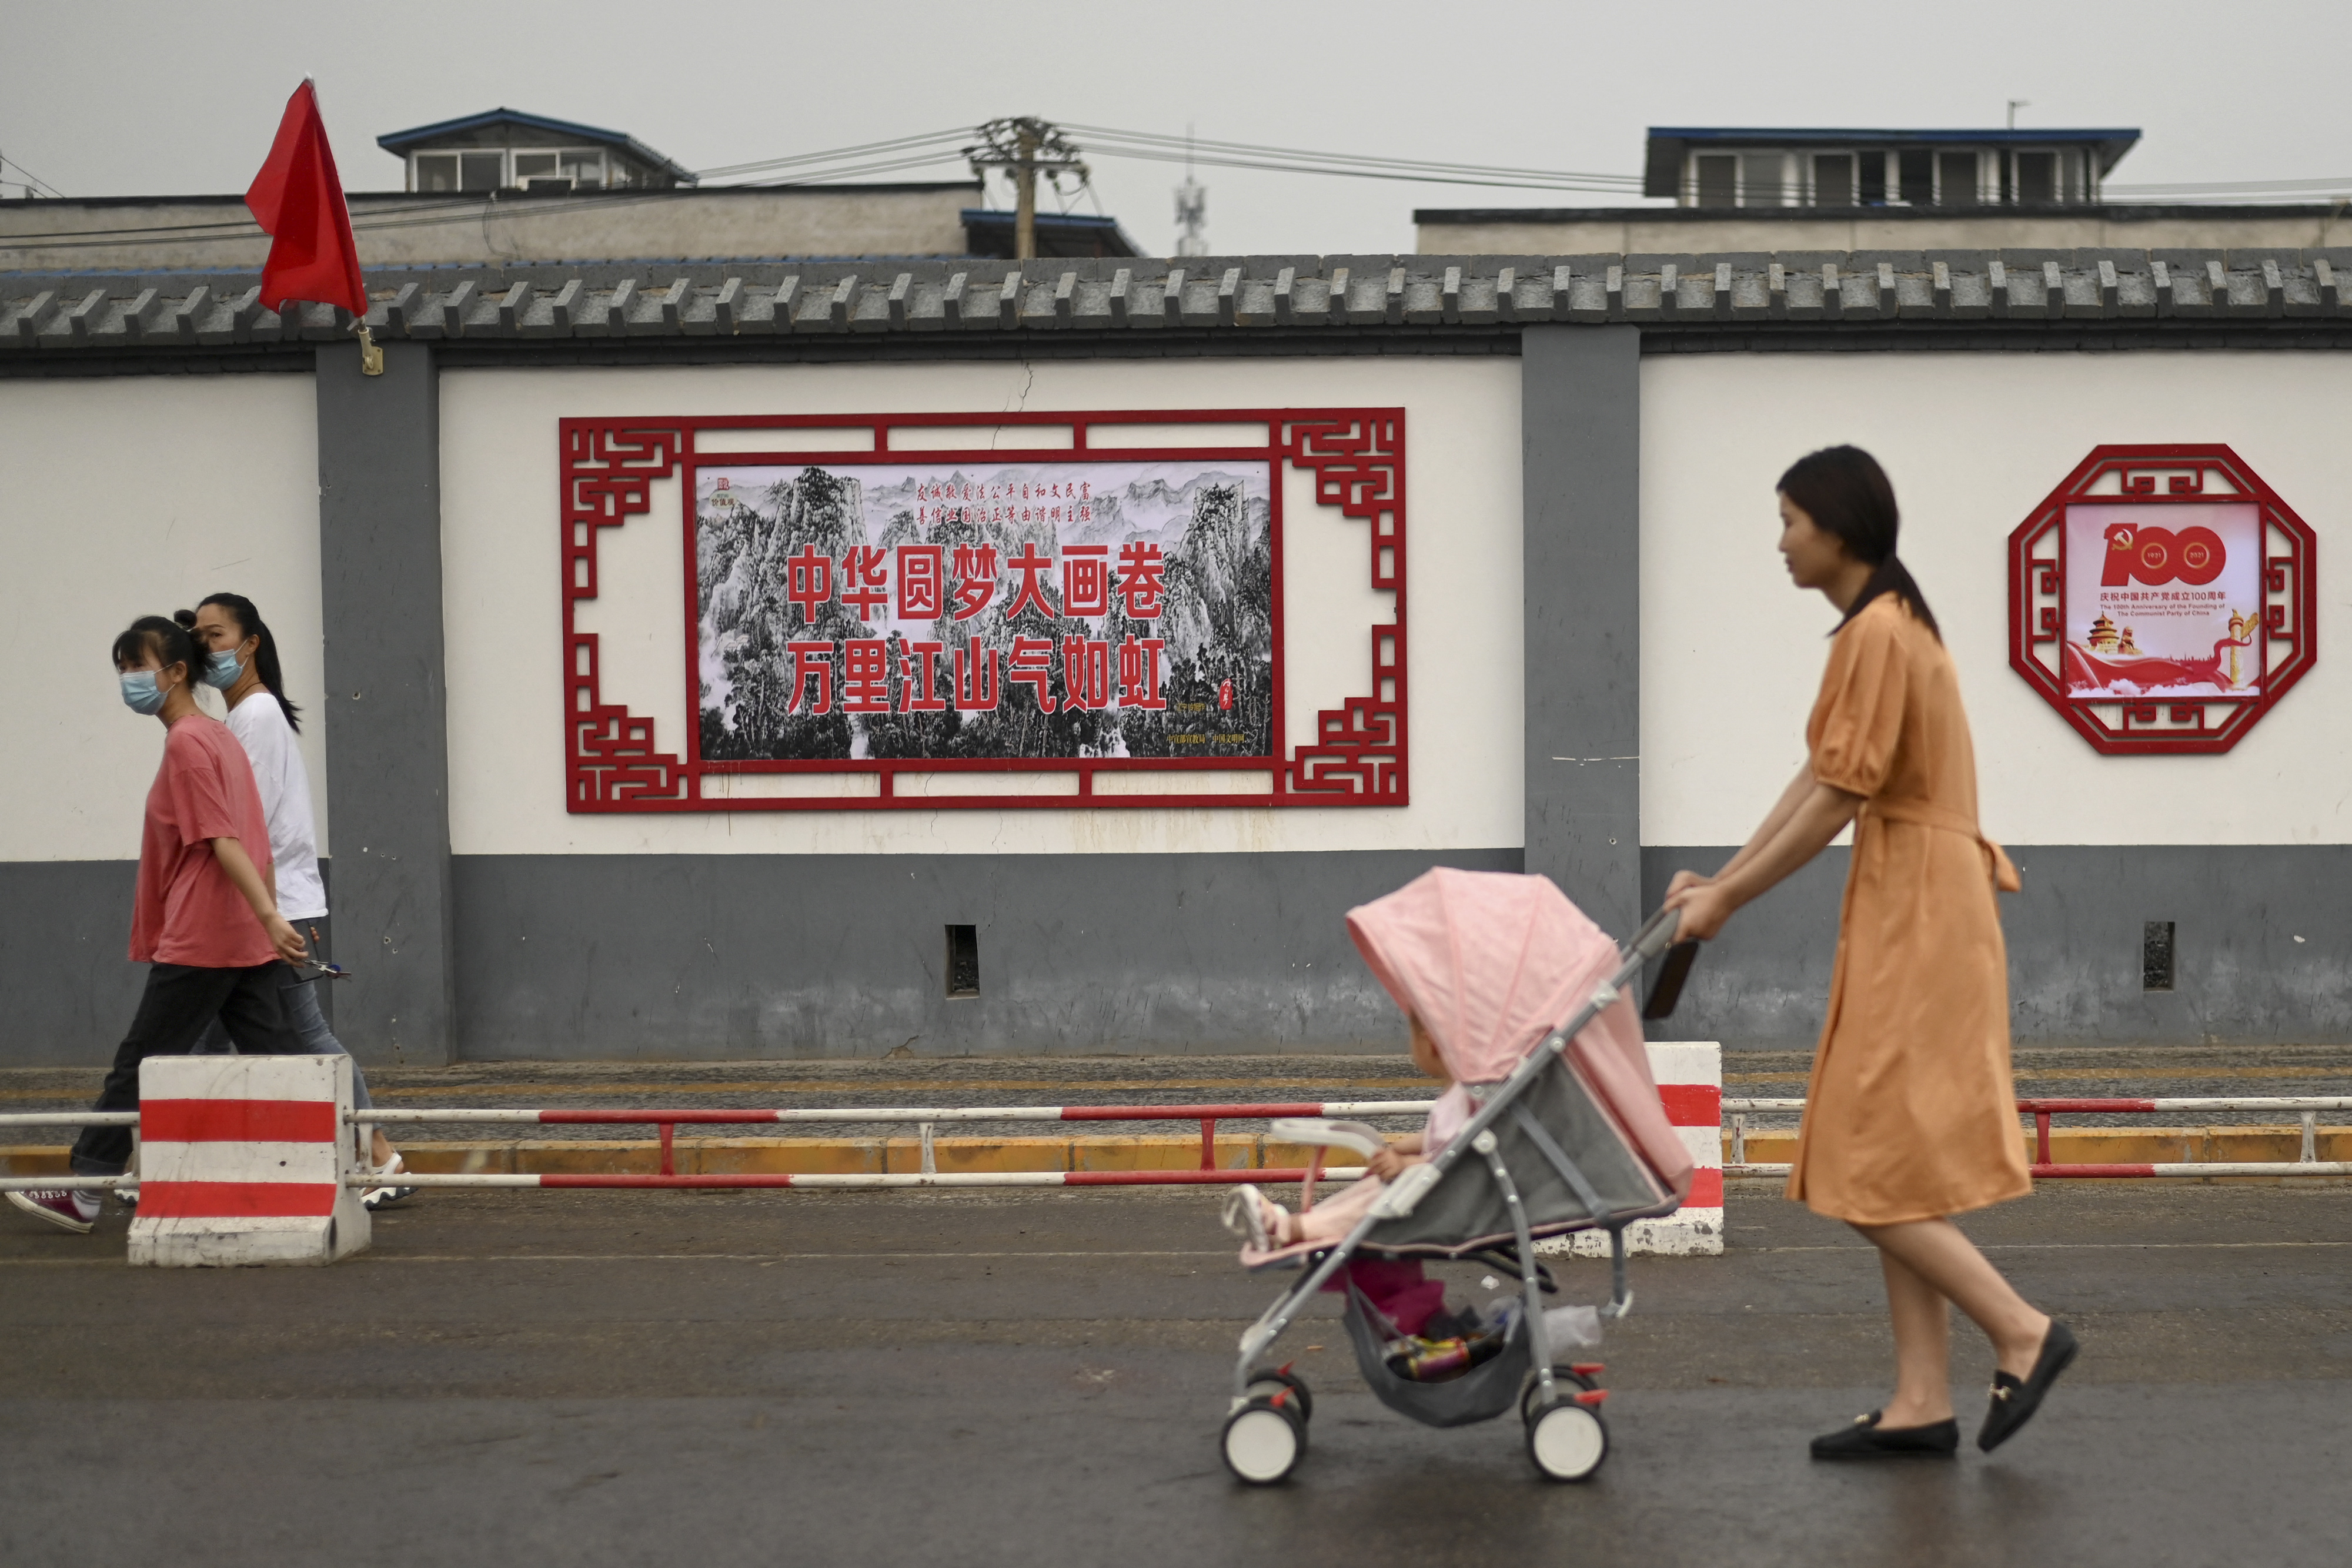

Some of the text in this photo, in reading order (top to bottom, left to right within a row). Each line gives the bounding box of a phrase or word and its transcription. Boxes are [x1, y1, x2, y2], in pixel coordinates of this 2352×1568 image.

[787, 540, 1164, 623] 中华圆梦大画卷
[2101, 523, 2226, 586] 100
[2100, 591, 2226, 601] 庆祝中国共产党成立100周年
[787, 634, 1167, 714] 万里江山气如虹
[1212, 733, 1245, 744] 中国文明网
